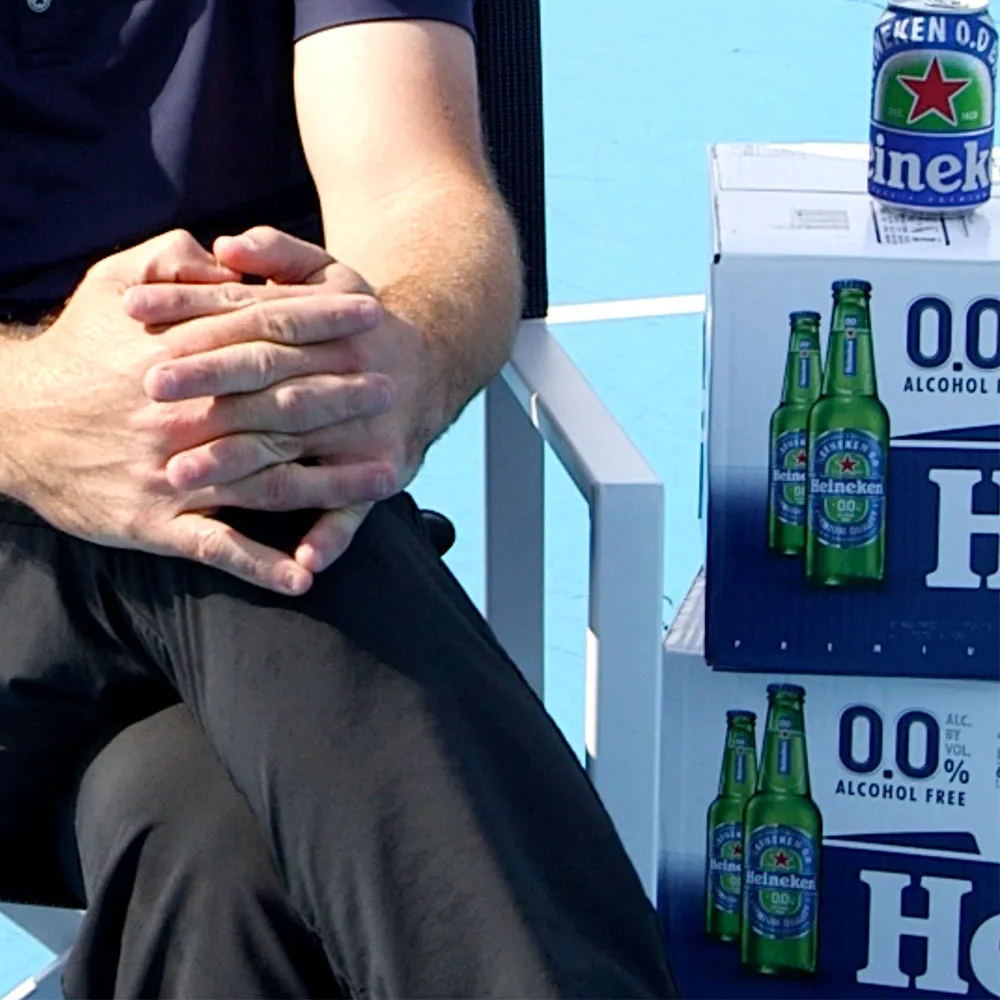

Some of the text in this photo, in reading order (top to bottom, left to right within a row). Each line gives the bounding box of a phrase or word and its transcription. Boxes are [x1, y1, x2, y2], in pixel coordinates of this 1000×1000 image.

[903, 376, 988, 394] ALCOHOL
[810, 478, 884, 495] Heineken
[945, 713, 973, 728] ALC.
[944, 742, 972, 758] VOL.
[835, 779, 967, 807] ALCOHOL FREE
[746, 870, 817, 890] Heineken
